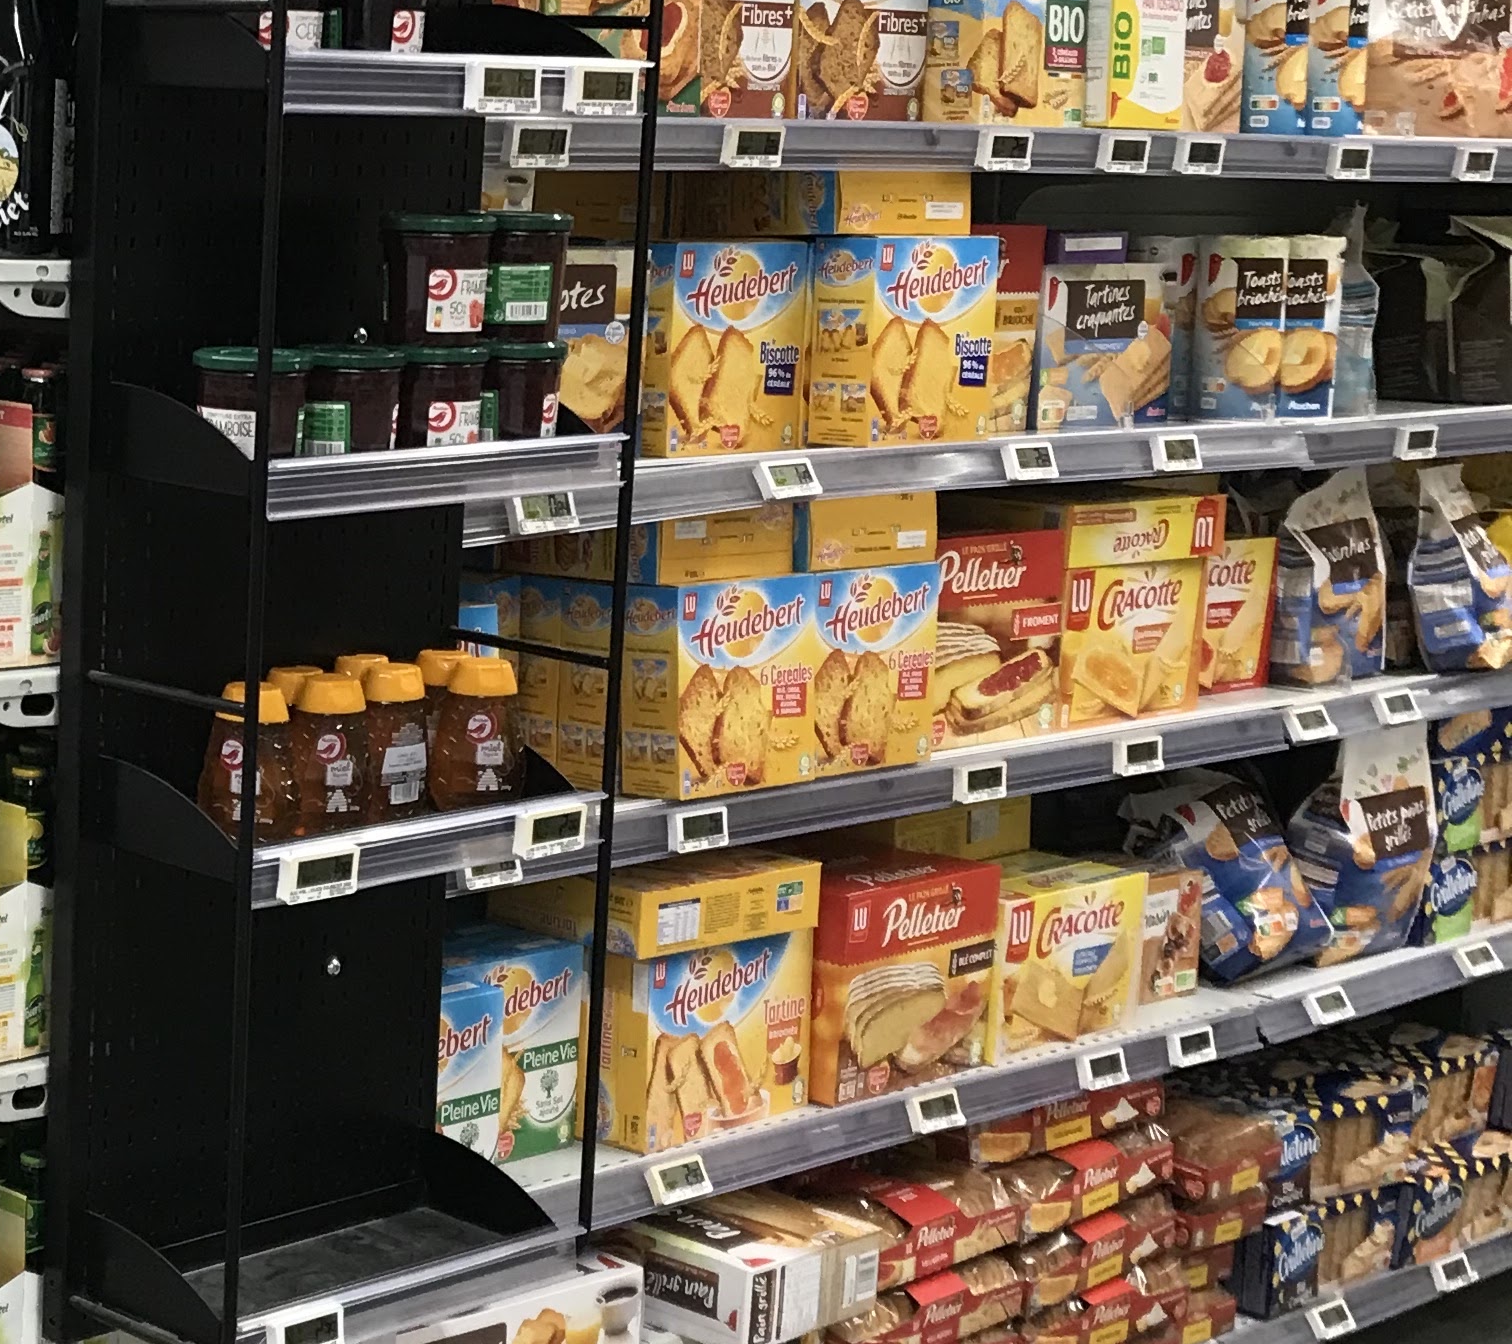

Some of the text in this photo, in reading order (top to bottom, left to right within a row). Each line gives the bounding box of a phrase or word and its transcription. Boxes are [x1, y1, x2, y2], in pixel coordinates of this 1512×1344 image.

[1048, 3, 1086, 44] BIO
[688, 262, 798, 318] Heudebert
[888, 256, 991, 311] Heudebert
[1085, 283, 1130, 309] Tartines
[1244, 270, 1283, 289] Toasts
[1076, 305, 1136, 338] craquantes
[759, 340, 800, 365] Biscotte
[955, 333, 992, 357] Biscotte
[939, 549, 1028, 595] Pelletier
[691, 595, 806, 658] Heudebert
[825, 583, 931, 645] Heudebert
[1022, 613, 1059, 628] FROMENT
[770, 662, 814, 686] Céréales
[881, 896, 967, 948] Pelletier
[504, 967, 573, 1018] debert
[664, 947, 773, 1027] Heudebert
[763, 994, 806, 1027] Tartine
[523, 1042, 577, 1070] Pleine Vie
[441, 1094, 499, 1124] Pleine Vie
